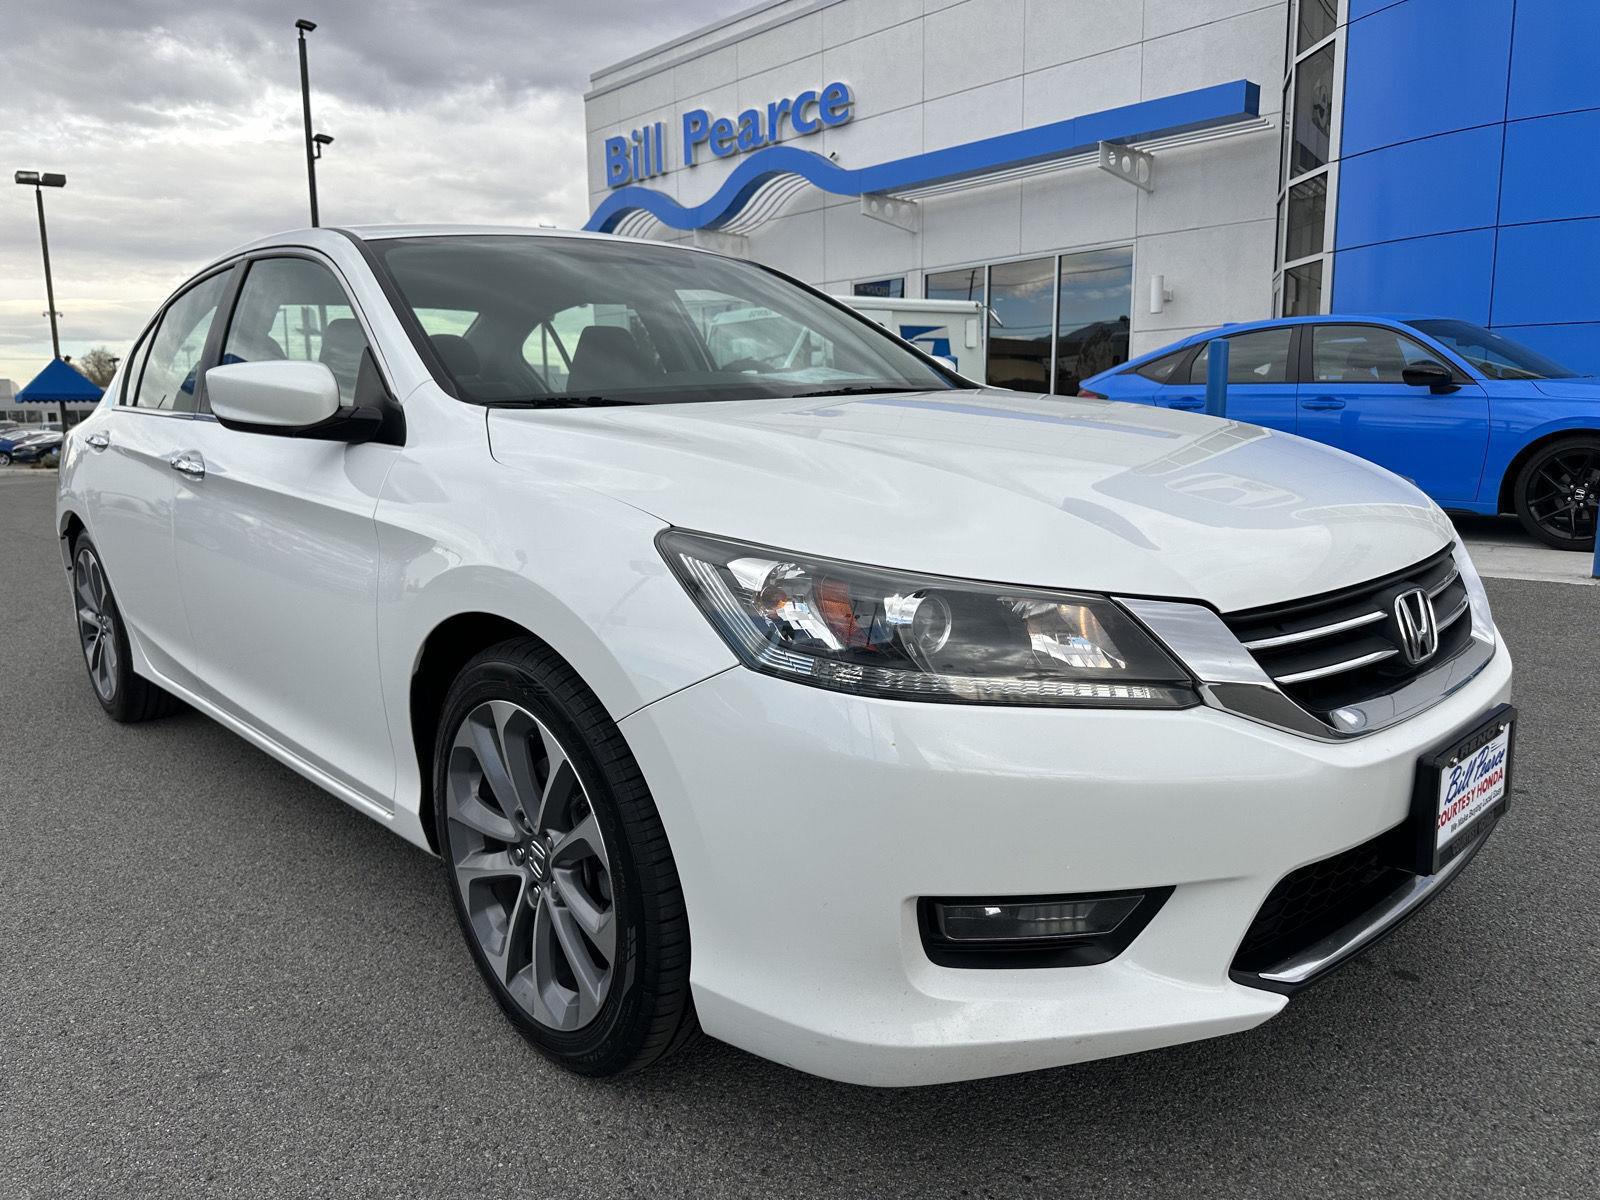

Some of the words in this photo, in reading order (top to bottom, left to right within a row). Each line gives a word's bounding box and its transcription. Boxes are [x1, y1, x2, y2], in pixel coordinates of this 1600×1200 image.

[605, 121, 665, 188] Bill
[683, 82, 853, 167] Pearce
[1459, 725, 1496, 758] RENO
[1444, 757, 1477, 806] Bill
[1474, 745, 1506, 783] Pearce
[1476, 766, 1503, 798] HONDA
